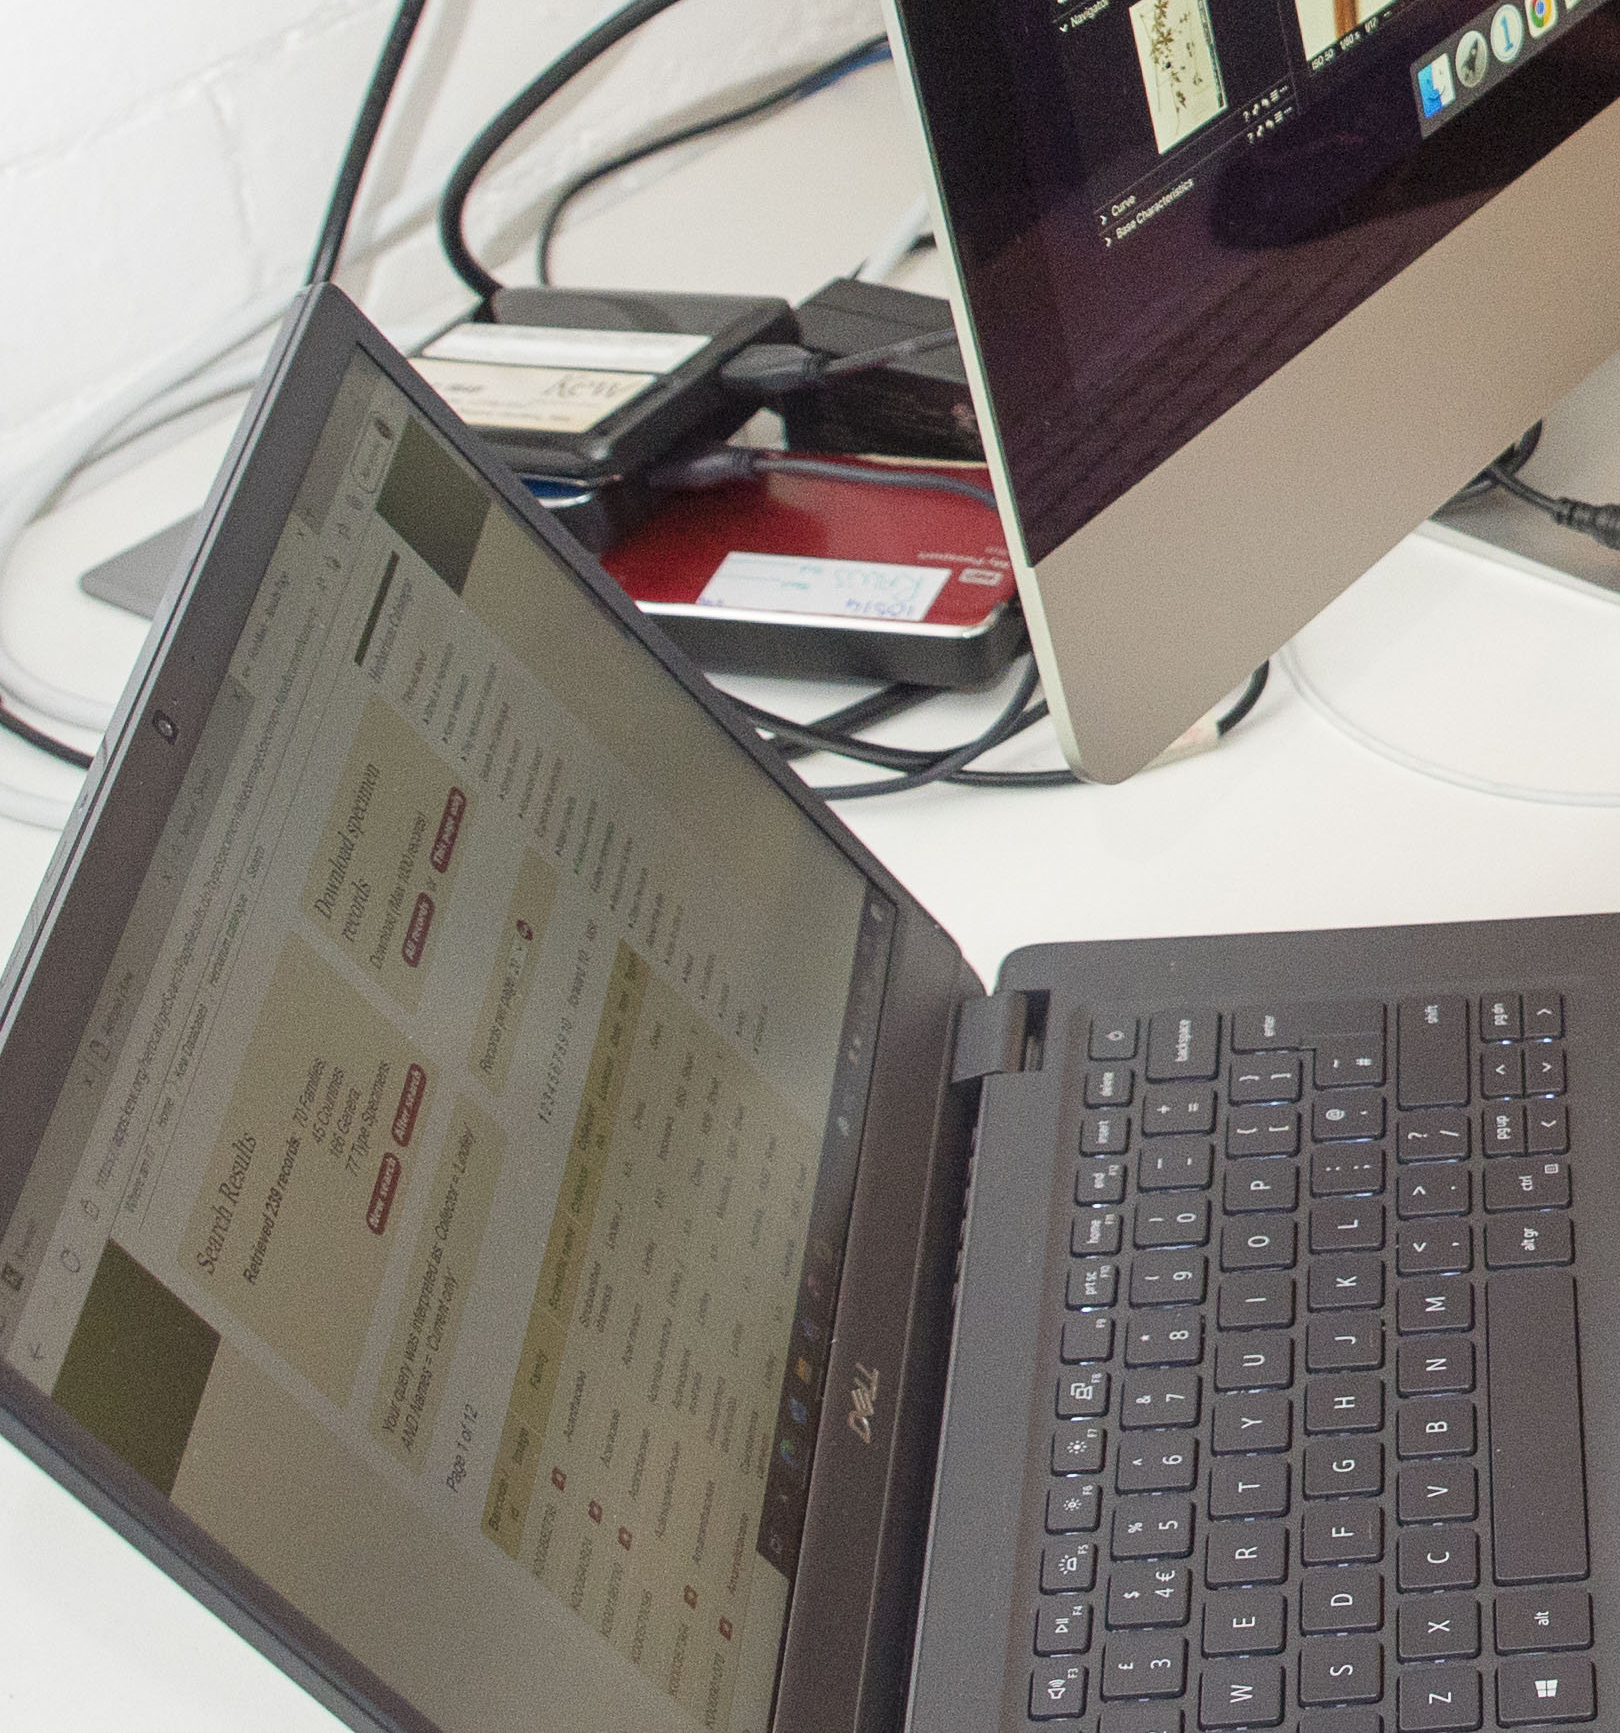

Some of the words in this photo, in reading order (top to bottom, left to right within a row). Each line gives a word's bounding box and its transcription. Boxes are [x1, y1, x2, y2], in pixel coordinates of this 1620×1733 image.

[1110, 190, 1136, 220] Curve
[1115, 214, 1139, 242] Base
[1139, 174, 1194, 225] Characteristics
[448, 790, 465, 820] only
[313, 830, 356, 922] Download
[342, 757, 386, 845] specimen
[441, 814, 458, 847] page
[433, 839, 448, 867] This
[338, 873, 372, 945] records
[409, 897, 430, 944] records
[370, 910, 397, 971] Download
[404, 938, 418, 962] All
[172, 1052, 190, 1081] Kew
[181, 999, 210, 1059] Databases
[245, 842, 266, 881] Search
[479, 1021, 502, 1077] Records
[493, 1002, 510, 1031] per
[394, 1106, 412, 1143] Alter
[403, 1065, 424, 1113] search
[310, 1121, 326, 1147] 45
[328, 1131, 347, 1164] 166
[350, 1122, 374, 1164] Type
[345, 1153, 361, 1179] 77
[194, 1197, 234, 1277] Search
[218, 1125, 258, 1207] Results
[242, 1211, 276, 1288] Retrieved
[265, 1185, 284, 1219] 239
[293, 1106, 310, 1131] 70
[368, 1195, 386, 1231] New
[377, 1153, 399, 1201] search
[434, 1181, 460, 1244] Collector
[409, 1258, 442, 1338] interpreted
[402, 1329, 420, 1364] was
[390, 1358, 416, 1409] query
[409, 1362, 433, 1418] Names
[849, 1361, 880, 1444] DELL
[381, 1398, 402, 1439] Your
[399, 1410, 420, 1454] AND
[458, 1420, 473, 1444] of
[462, 1401, 478, 1427] 12
[446, 1449, 469, 1497] Page
[1238, 1482, 1260, 1492] T
[1332, 1528, 1353, 1537] F
[1235, 1547, 1258, 1559] R
[1428, 1551, 1450, 1563] C
[1233, 1617, 1255, 1627] E
[1428, 1620, 1451, 1633] X
[1534, 1611, 1549, 1625] alt
[1230, 1684, 1253, 1702] W
[1429, 1692, 1451, 1703] Z
